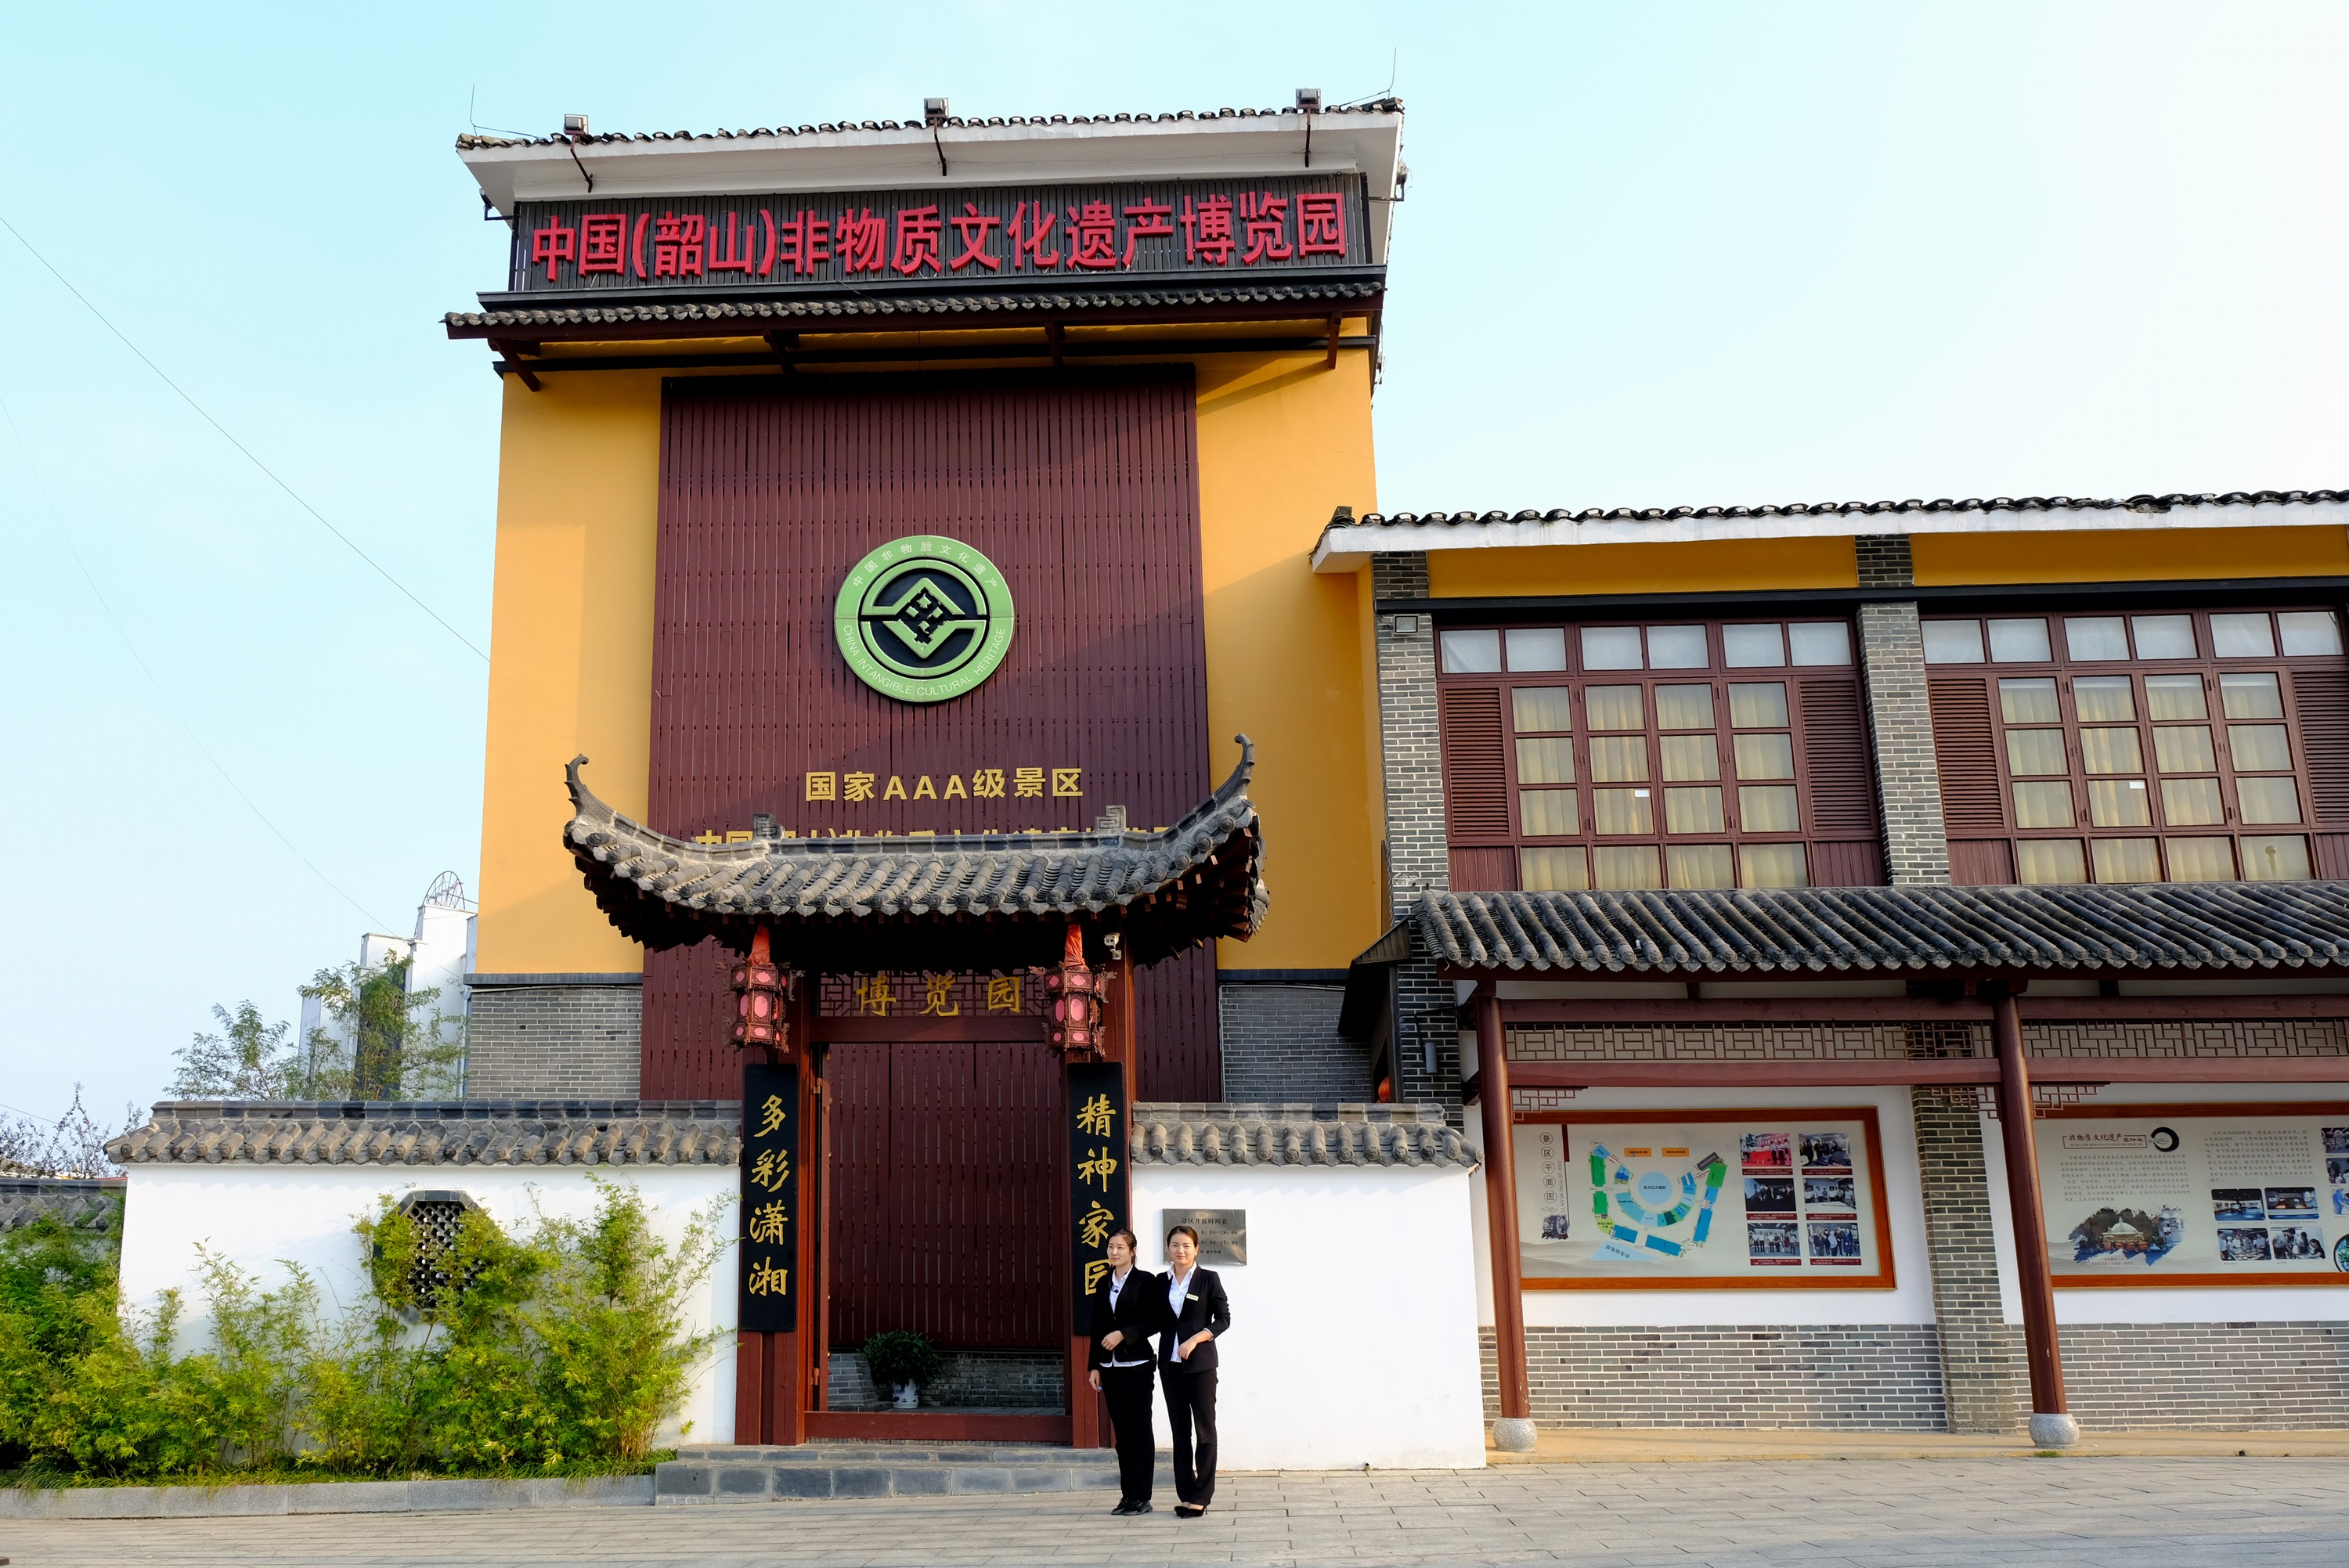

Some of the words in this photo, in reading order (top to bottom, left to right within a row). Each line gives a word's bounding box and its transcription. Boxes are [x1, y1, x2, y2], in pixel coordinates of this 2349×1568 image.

[532, 191, 1348, 280] 中国(韶山)非物质文化遗产博览园
[853, 542, 998, 588] 中国非物质文化遗产
[843, 625, 861, 657] CHINA
[857, 658, 912, 694] INTANGIBLE
[917, 675, 973, 696] CULTURAL
[972, 627, 1005, 676] HERITAGE
[806, 767, 1084, 801] 国家AAA级景区
[856, 975, 1020, 1017] 博览园
[749, 1094, 789, 1296] 多彩潇湘
[1542, 1134, 1555, 1201] 景区平面图
